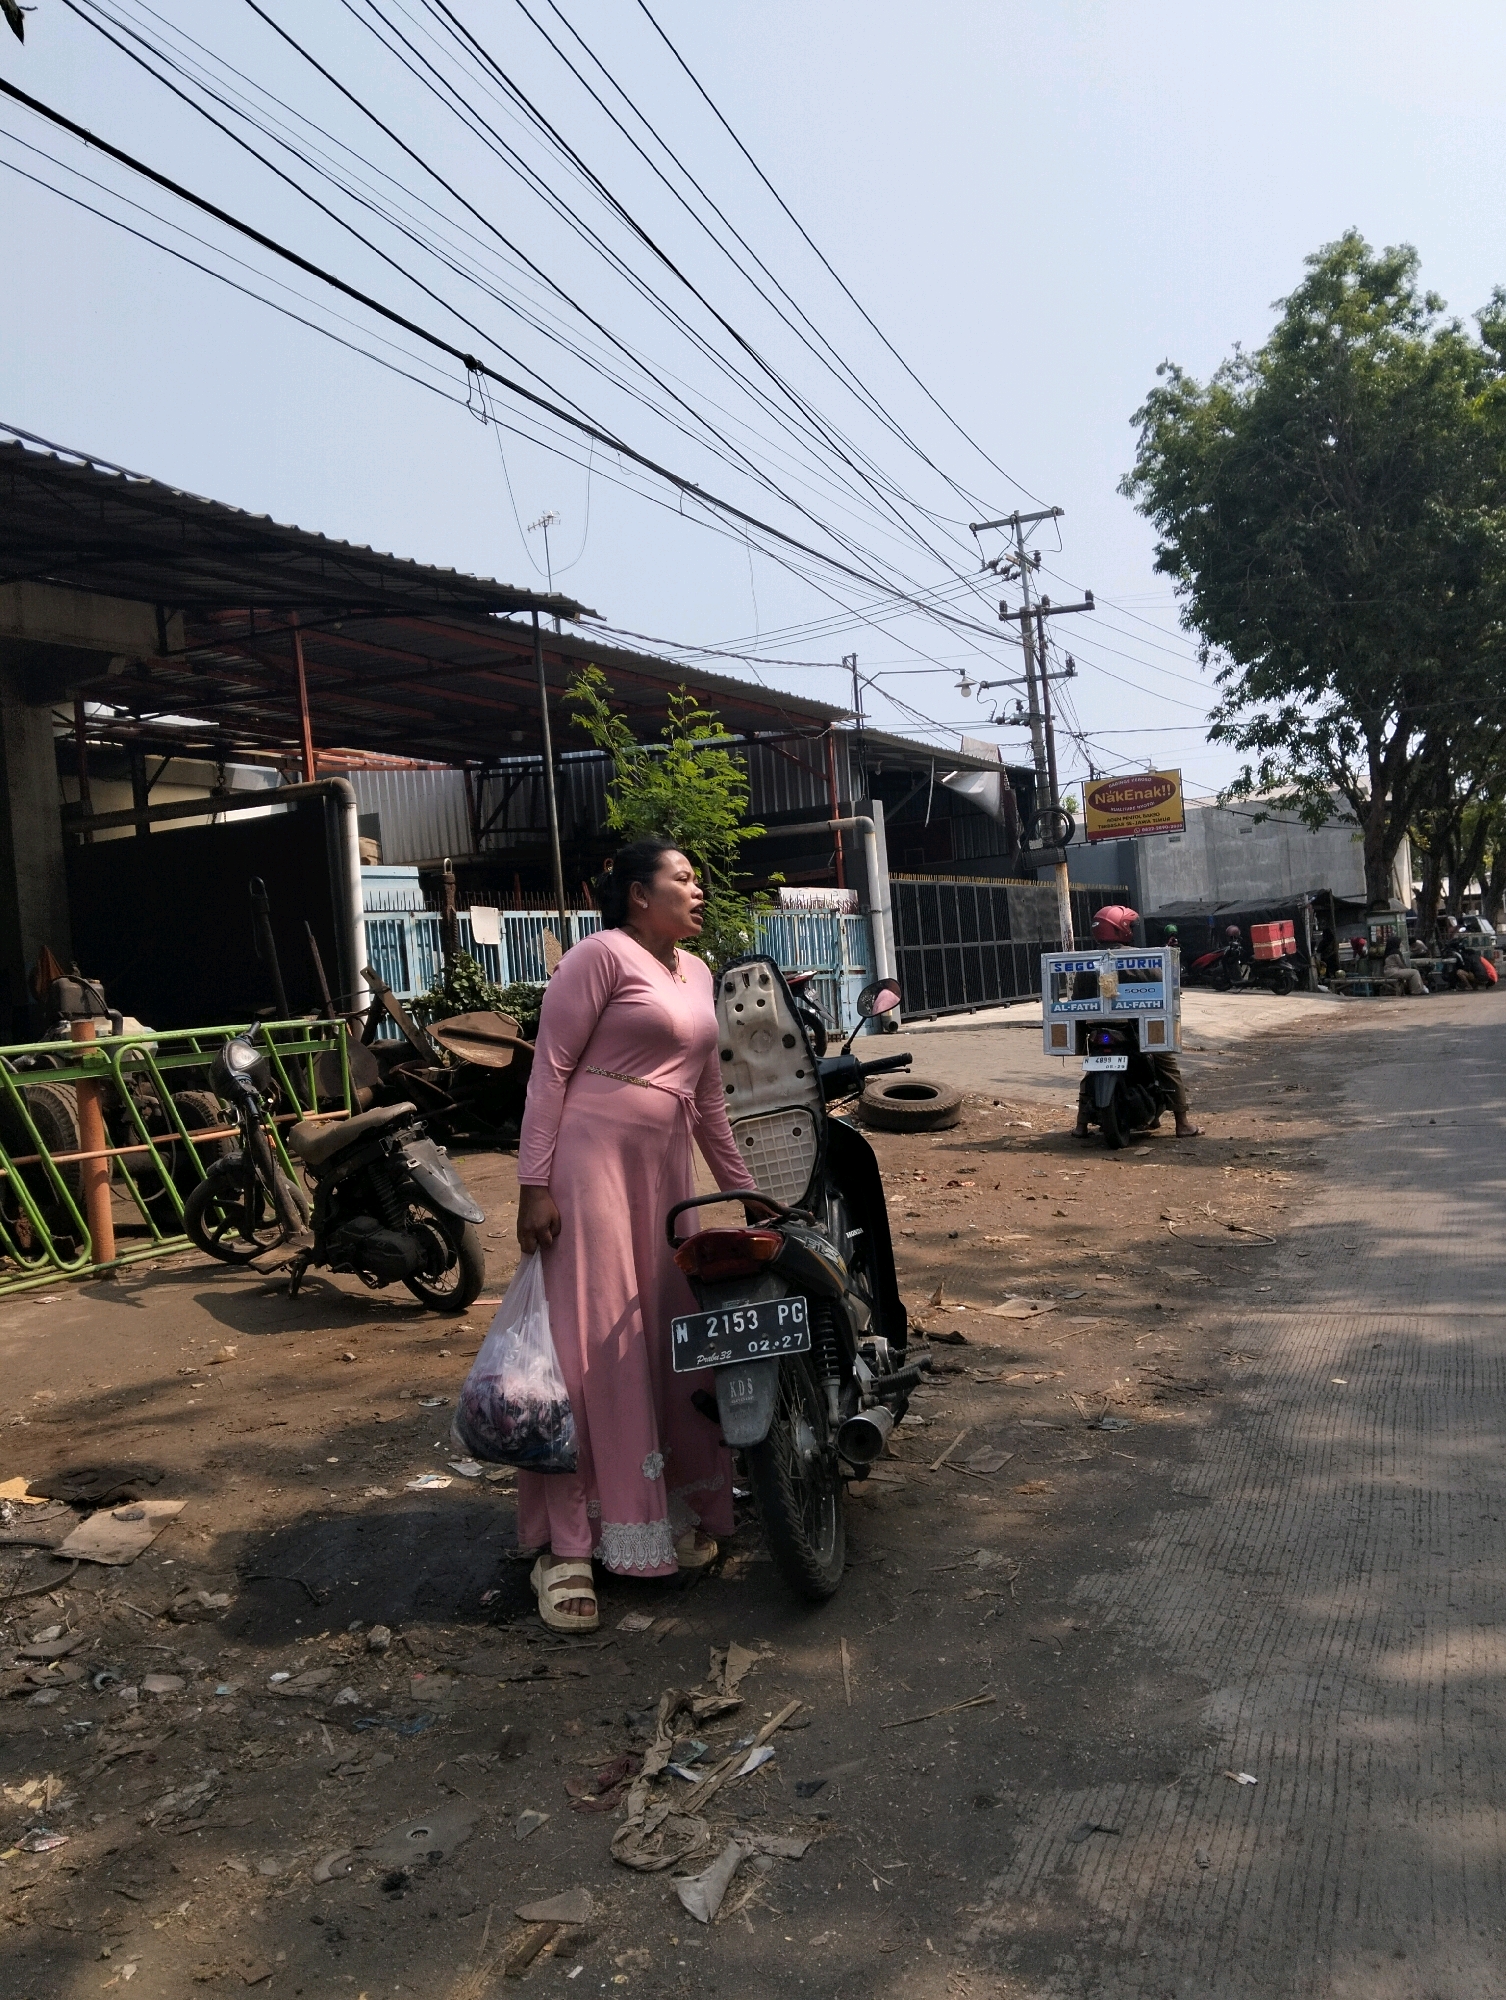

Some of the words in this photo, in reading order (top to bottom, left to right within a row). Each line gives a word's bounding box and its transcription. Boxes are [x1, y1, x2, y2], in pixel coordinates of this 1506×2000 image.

[1054, 961, 1095, 972] SEGO
[1115, 959, 1162, 969] GURIH
[1053, 1002, 1098, 1012] AL-FATH
[1115, 1001, 1161, 1009] AL-FATH
[675, 1321, 689, 1344] N
[706, 1309, 759, 1338] 2153
[777, 1302, 804, 1326] PG
[729, 1377, 754, 1398] KDS
